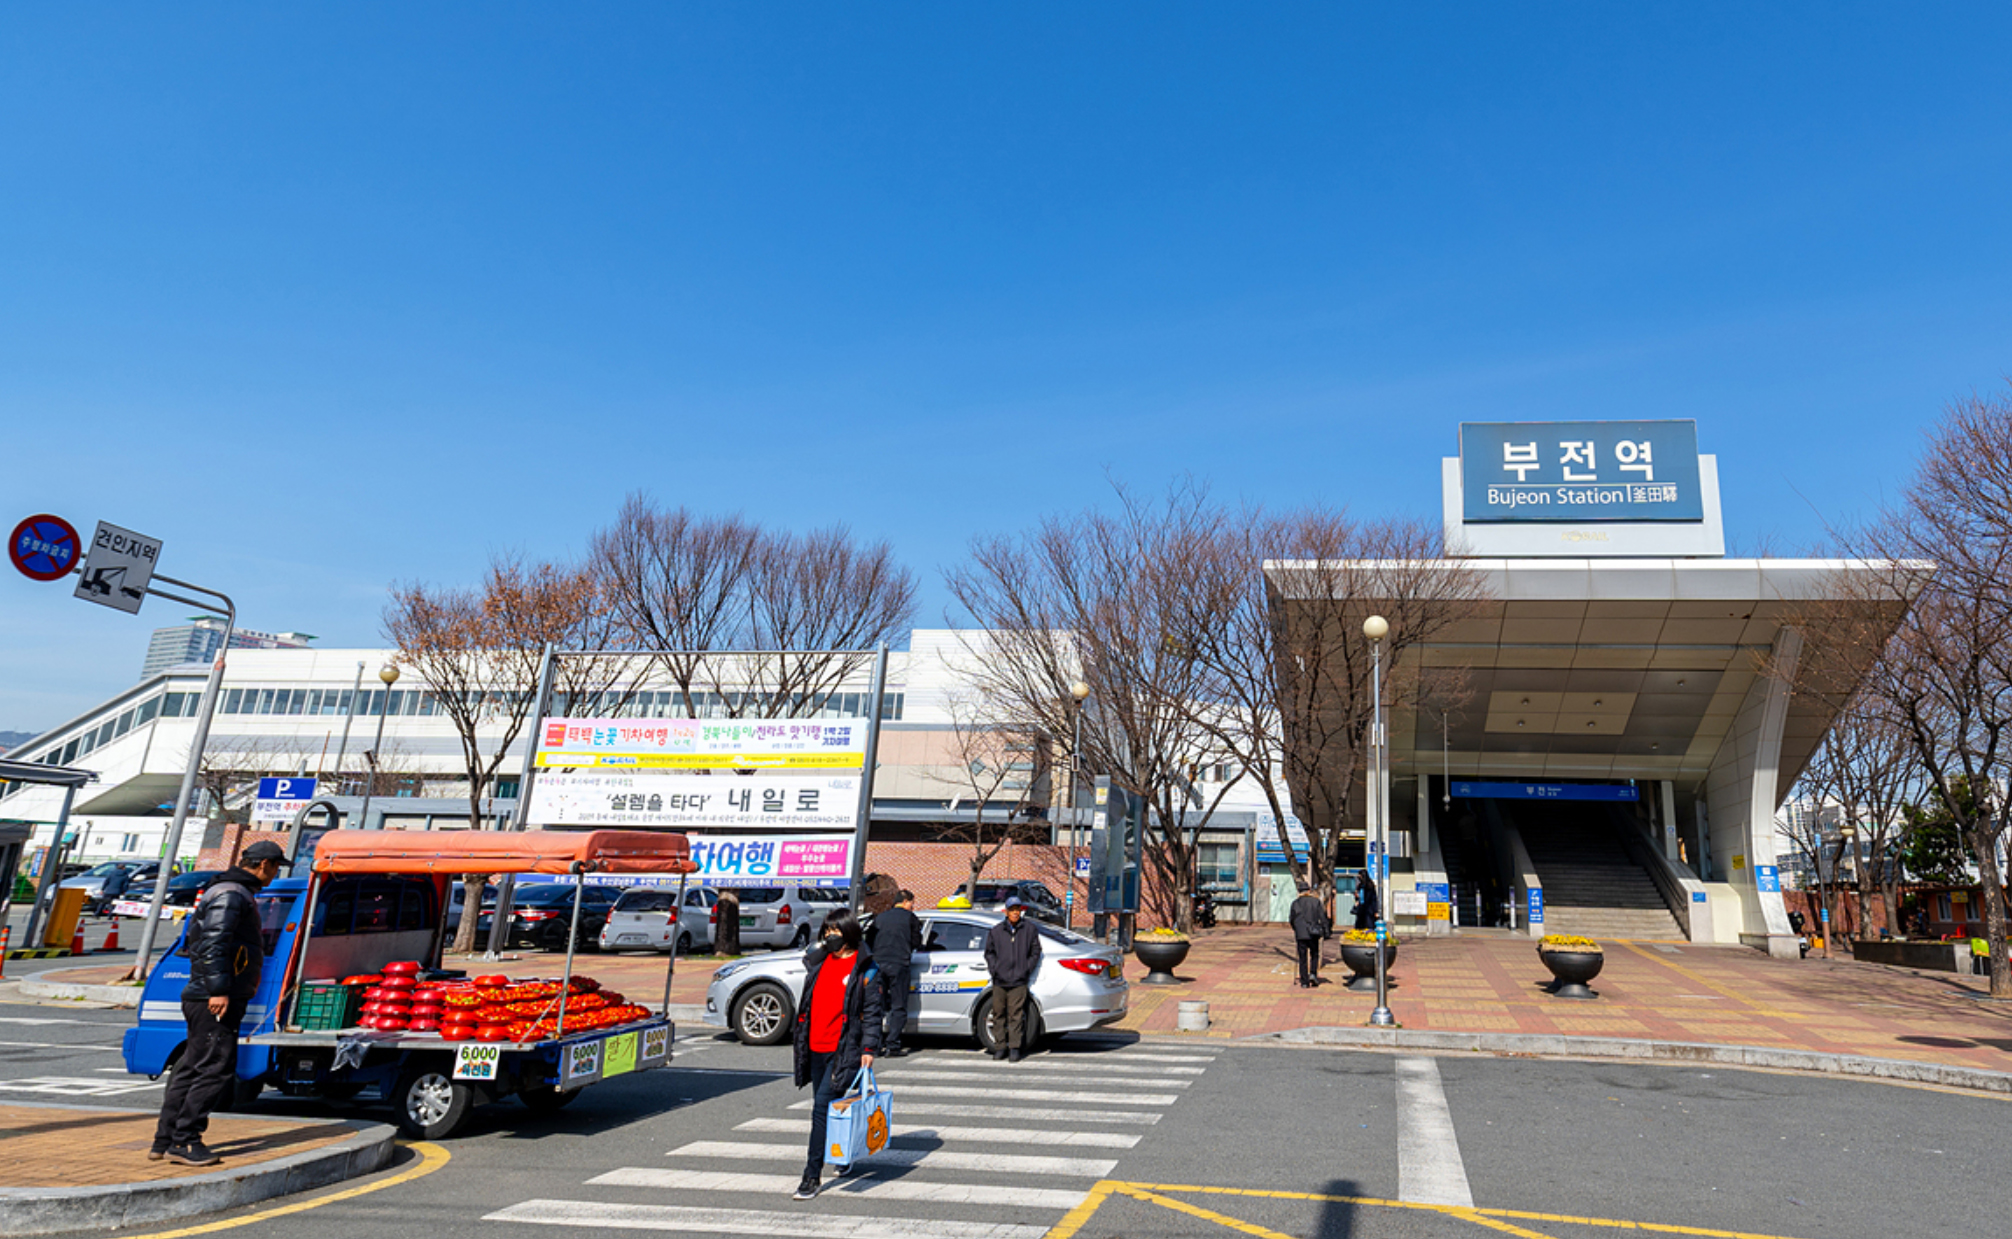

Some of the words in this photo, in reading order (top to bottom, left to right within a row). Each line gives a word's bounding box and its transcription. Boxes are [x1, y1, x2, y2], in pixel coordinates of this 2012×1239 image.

[1502, 440, 1654, 482] 부전역
[1487, 488, 1551, 508] Bujeon
[1556, 487, 1624, 505] Station
[21, 536, 70, 559] 주정차금지
[95, 528, 158, 564] 견인지역
[620, 727, 669, 747] 기차여행
[275, 779, 292, 798] P
[728, 788, 820, 813] 내일로
